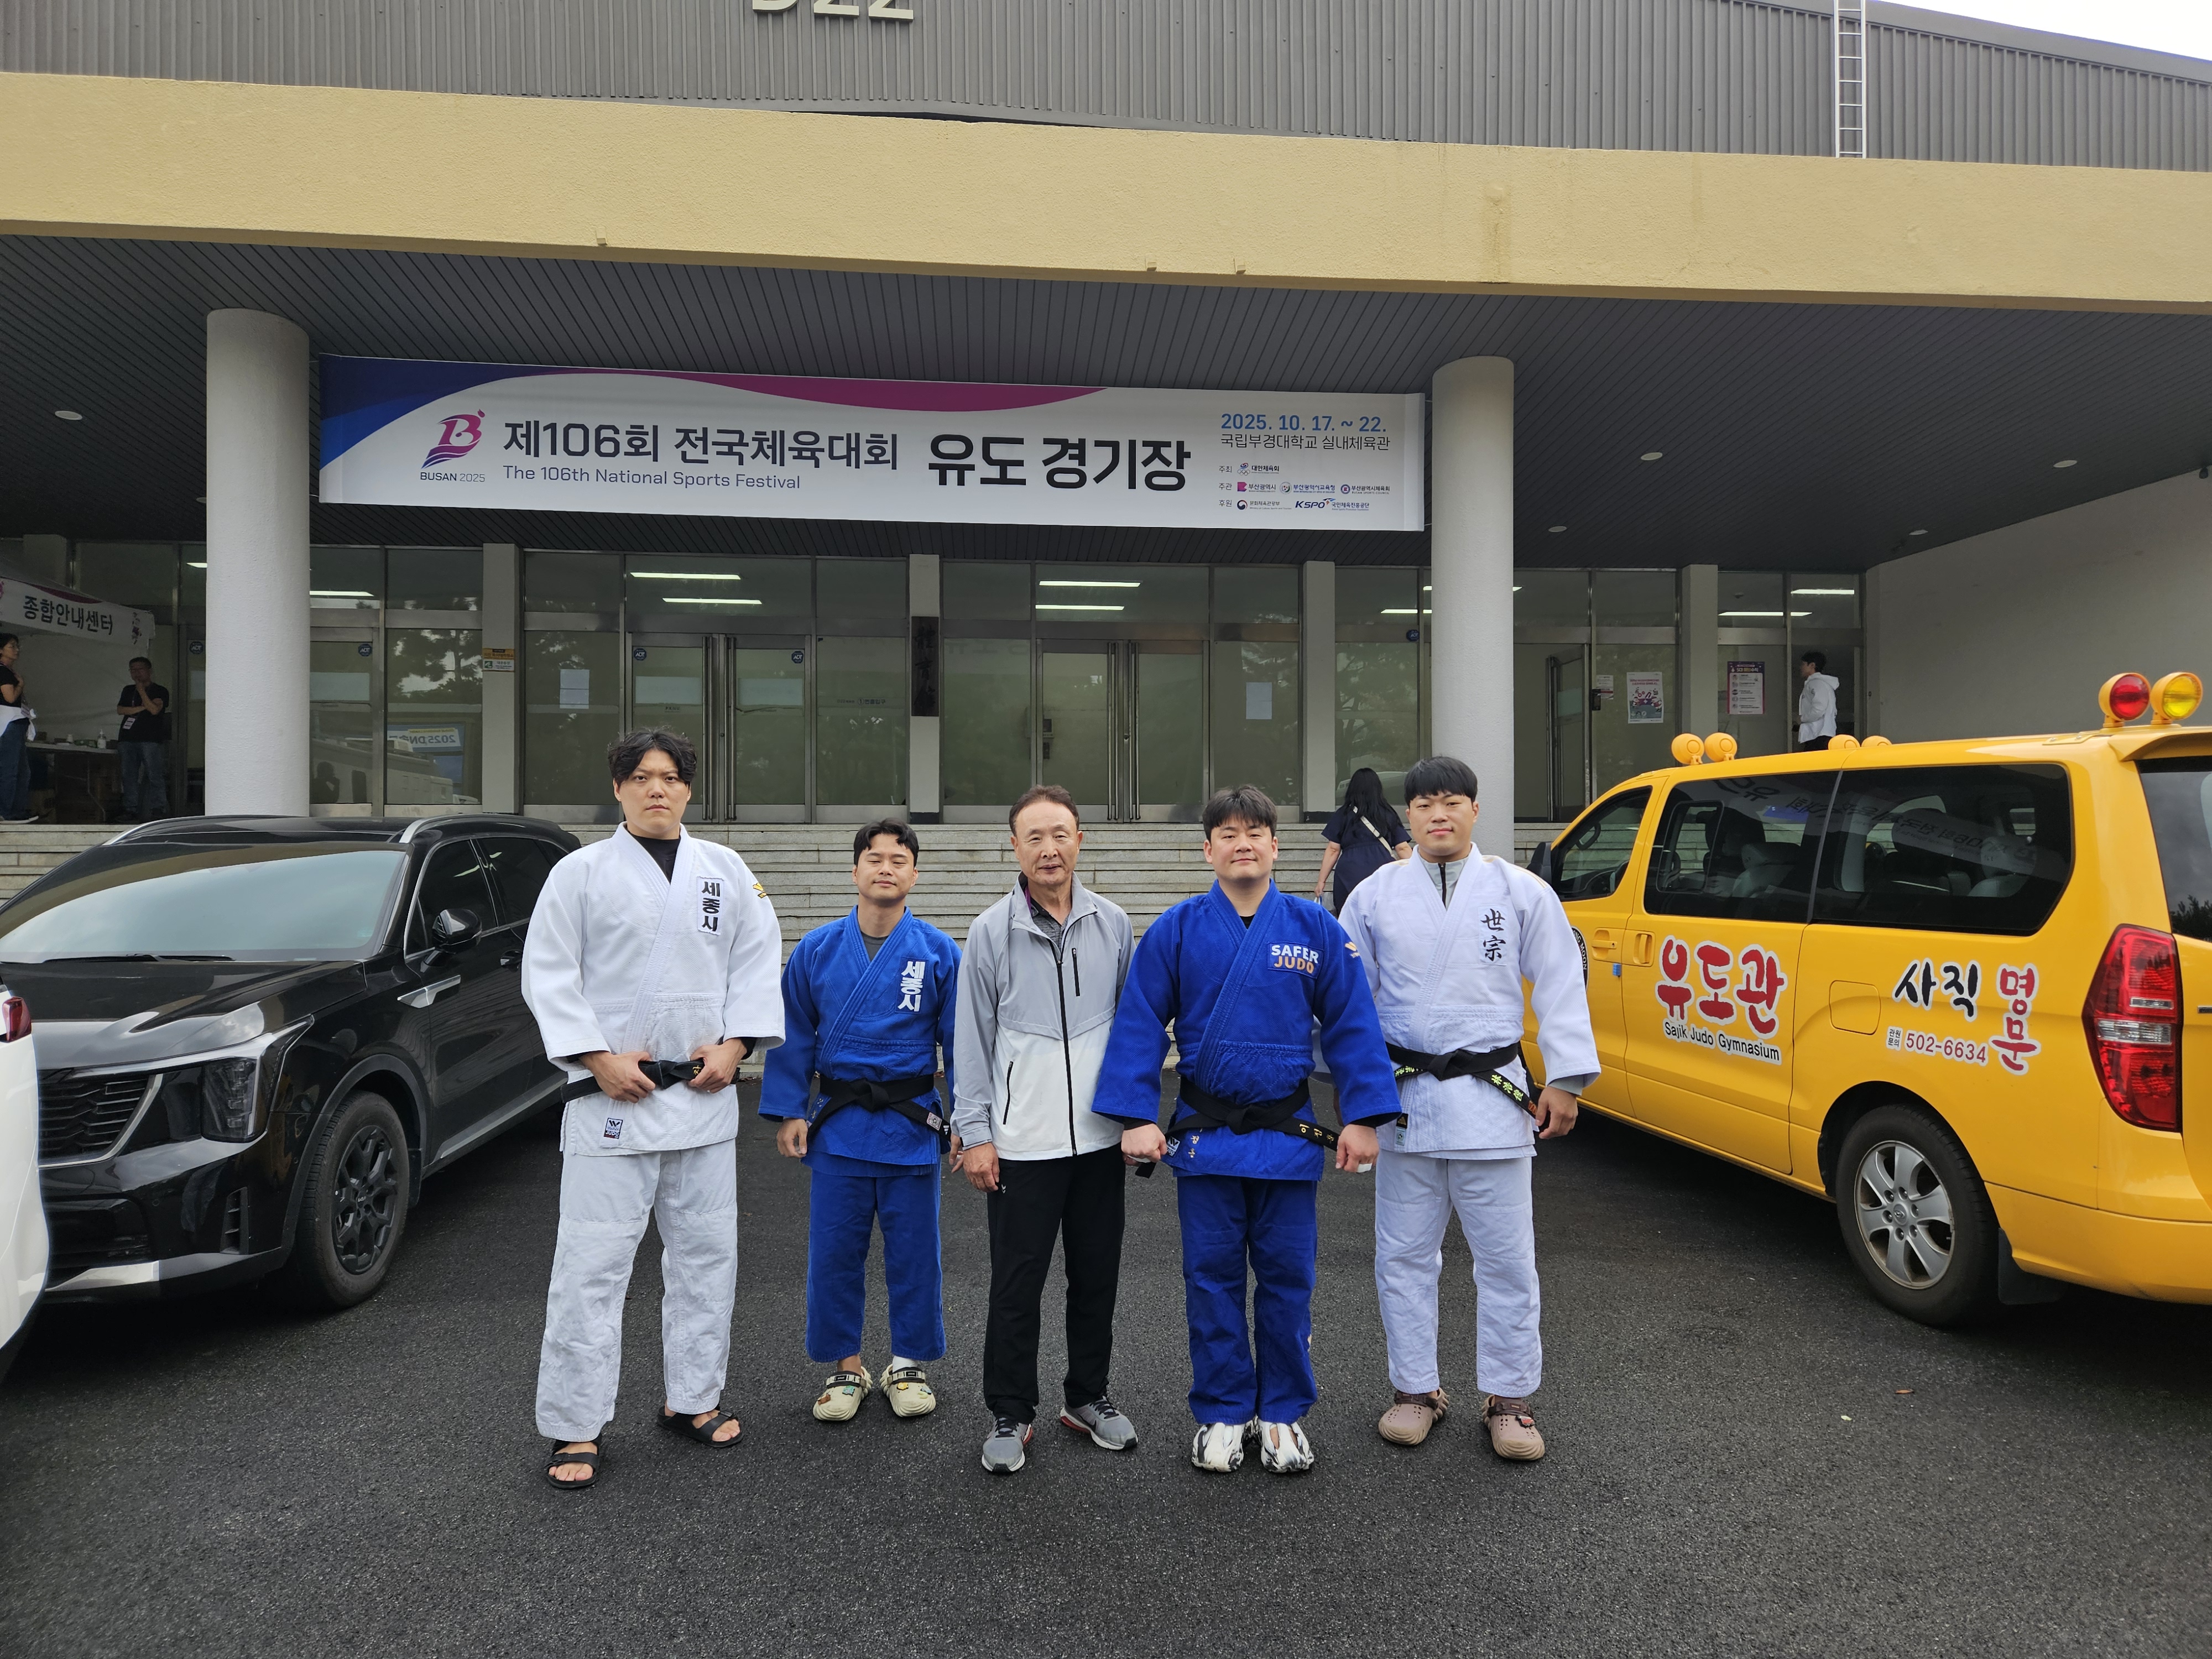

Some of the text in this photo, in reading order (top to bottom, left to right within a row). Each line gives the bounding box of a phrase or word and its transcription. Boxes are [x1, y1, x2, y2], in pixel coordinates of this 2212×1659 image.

[1221, 413, 1272, 430] 2025.
[1279, 415, 1305, 431] 10.
[1312, 416, 1335, 431] 17.
[1359, 416, 1387, 432] 22.
[504, 420, 1191, 492] 제106회 전국체육대회 유도 경기장
[1220, 434, 1390, 451] 국립부경대학교 실내체육관
[420, 472, 486, 483] BUSAN 2025
[503, 466, 800, 489] The 106th National Sports Festival
[23, 594, 113, 635] 종합안내센터
[701, 881, 722, 933] 세종시
[1480, 908, 1506, 962] 世宗
[1271, 944, 1319, 964] SAFER
[1274, 956, 1314, 974] JUDO
[898, 961, 926, 1012] 세종시
[1657, 939, 1785, 1034] 유도관
[1895, 961, 1978, 1018] 사직
[1890, 1029, 1901, 1039] 관원
[1992, 968, 2037, 1071] 명문
[1665, 1021, 1780, 1061] Sajik Judo Gymnasium
[1888, 1037, 1900, 1047] 문의
[1906, 1032, 1986, 1063] 502-6634
